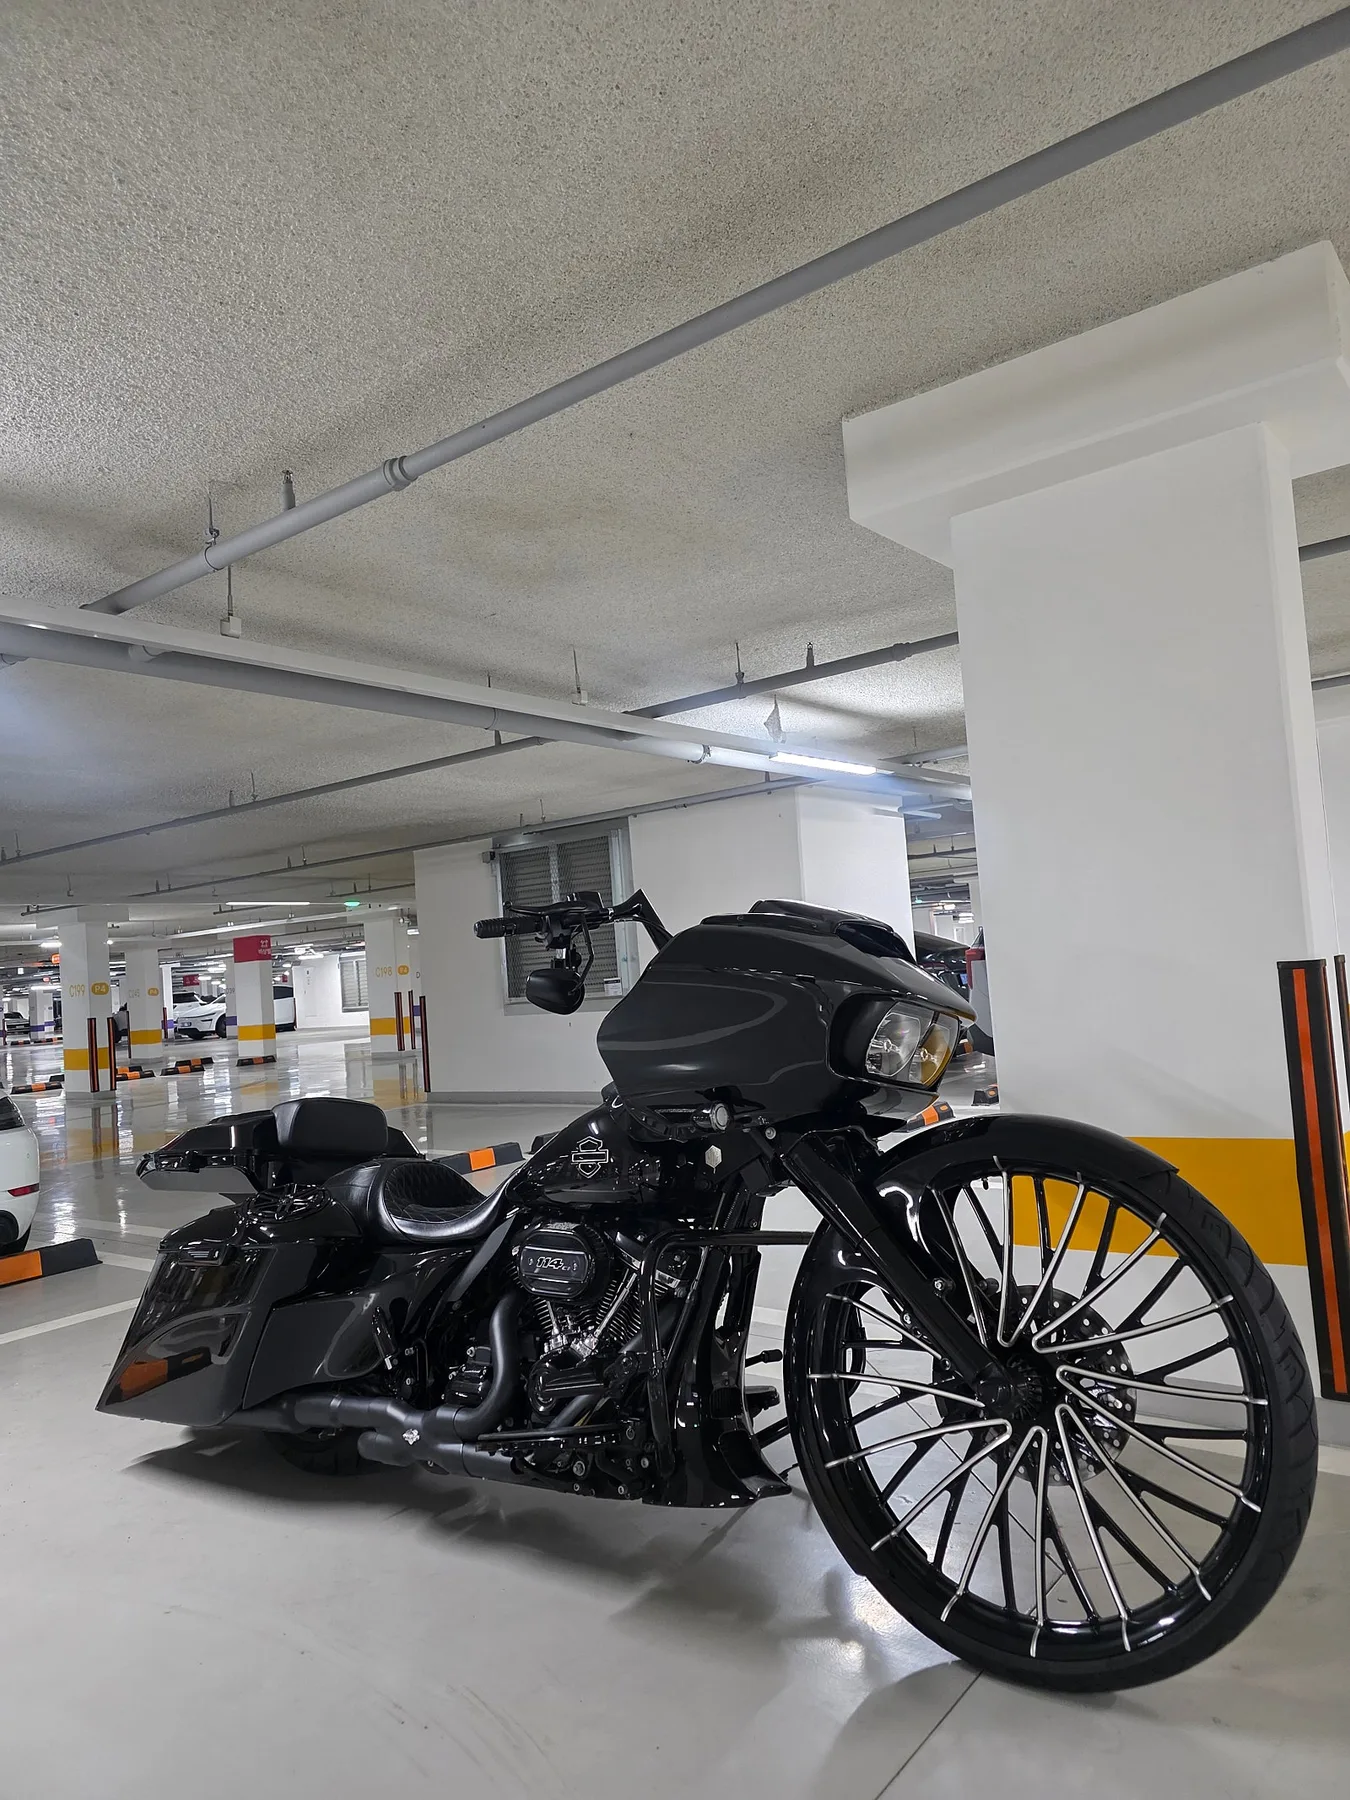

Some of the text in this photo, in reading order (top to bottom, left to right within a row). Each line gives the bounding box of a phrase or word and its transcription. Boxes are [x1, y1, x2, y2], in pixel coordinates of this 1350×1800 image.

[375, 966, 393, 977] C198
[69, 984, 86, 998] C199
[94, 984, 106, 993] P4
